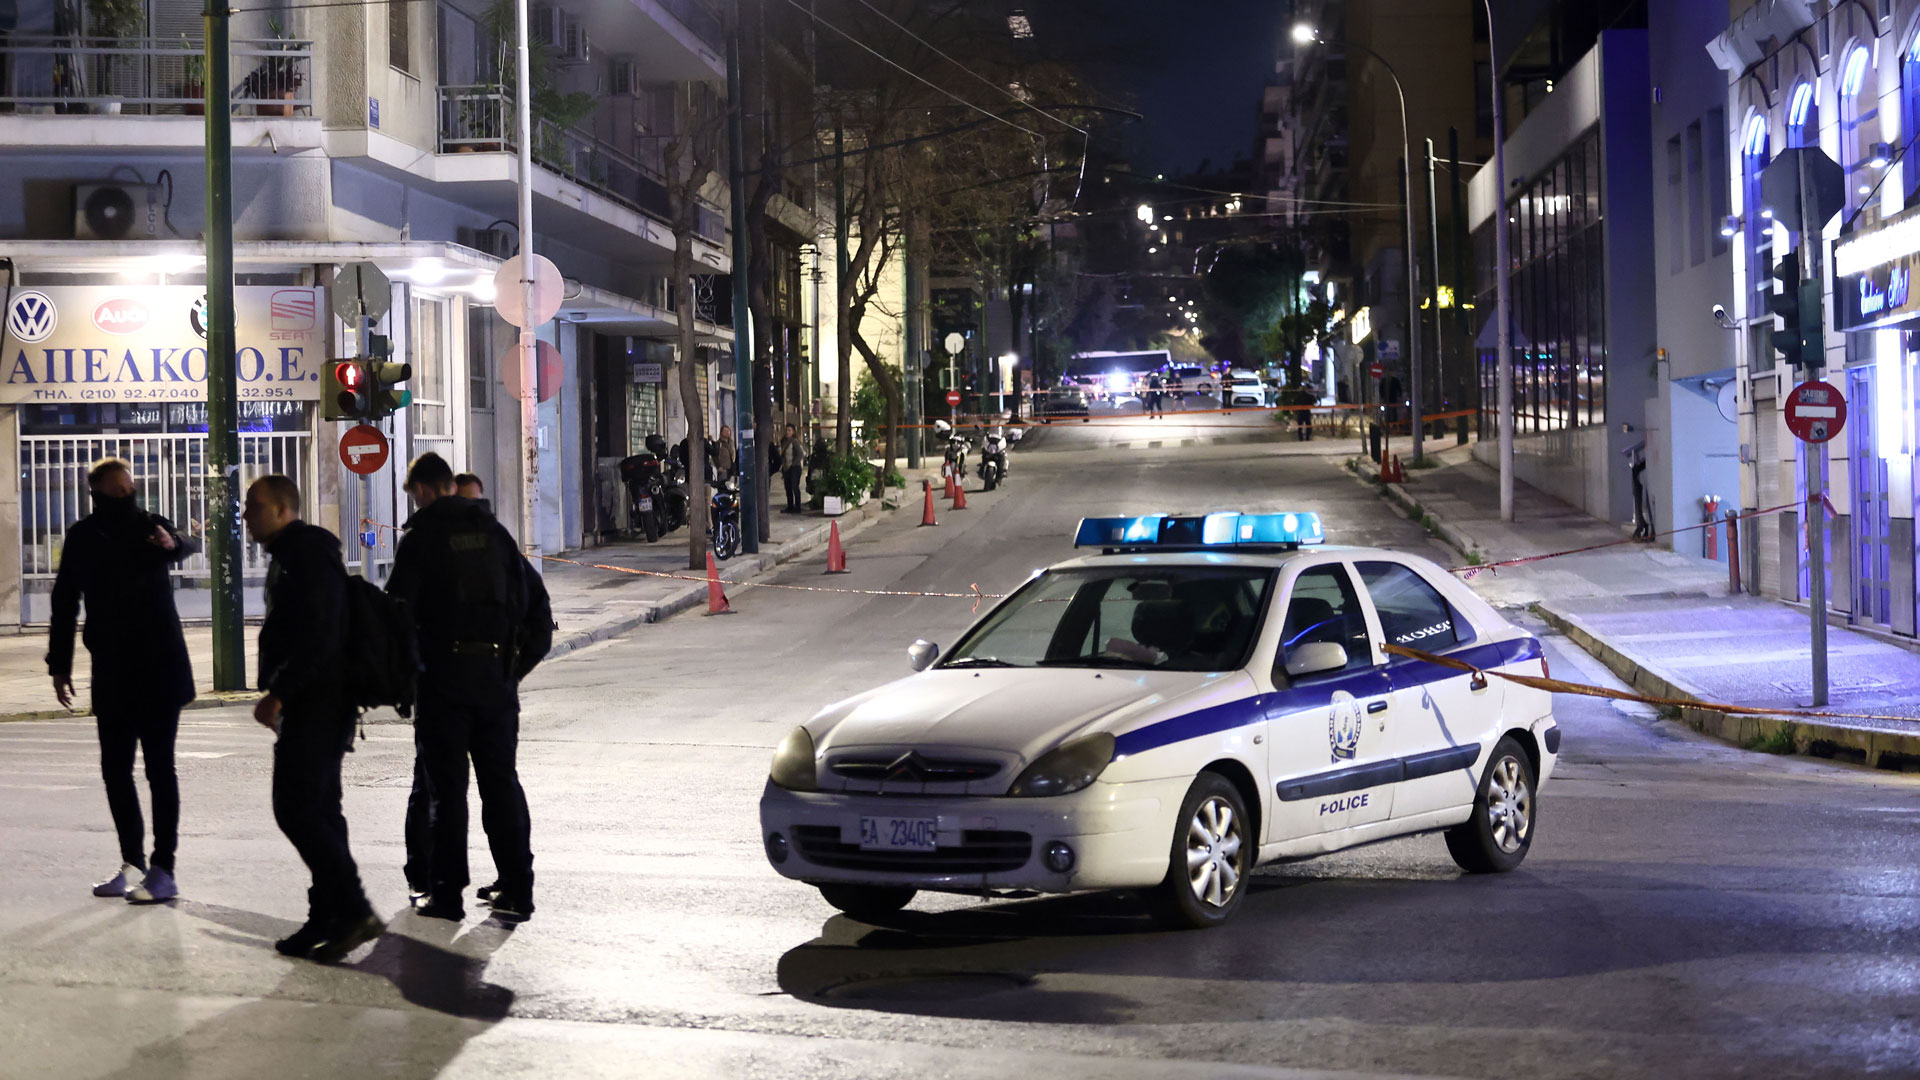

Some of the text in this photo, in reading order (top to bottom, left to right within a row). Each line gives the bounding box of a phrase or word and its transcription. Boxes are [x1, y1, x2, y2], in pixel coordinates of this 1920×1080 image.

[97, 305, 149, 325] Audi
[269, 331, 314, 341] SEAT
[33, 389, 73, 400] ΤΗΛ.
[80, 388, 116, 400] (210)
[123, 388, 199, 399] 92.47.040
[1319, 793, 1369, 816] POLICE
[889, 819, 936, 847] 23405
